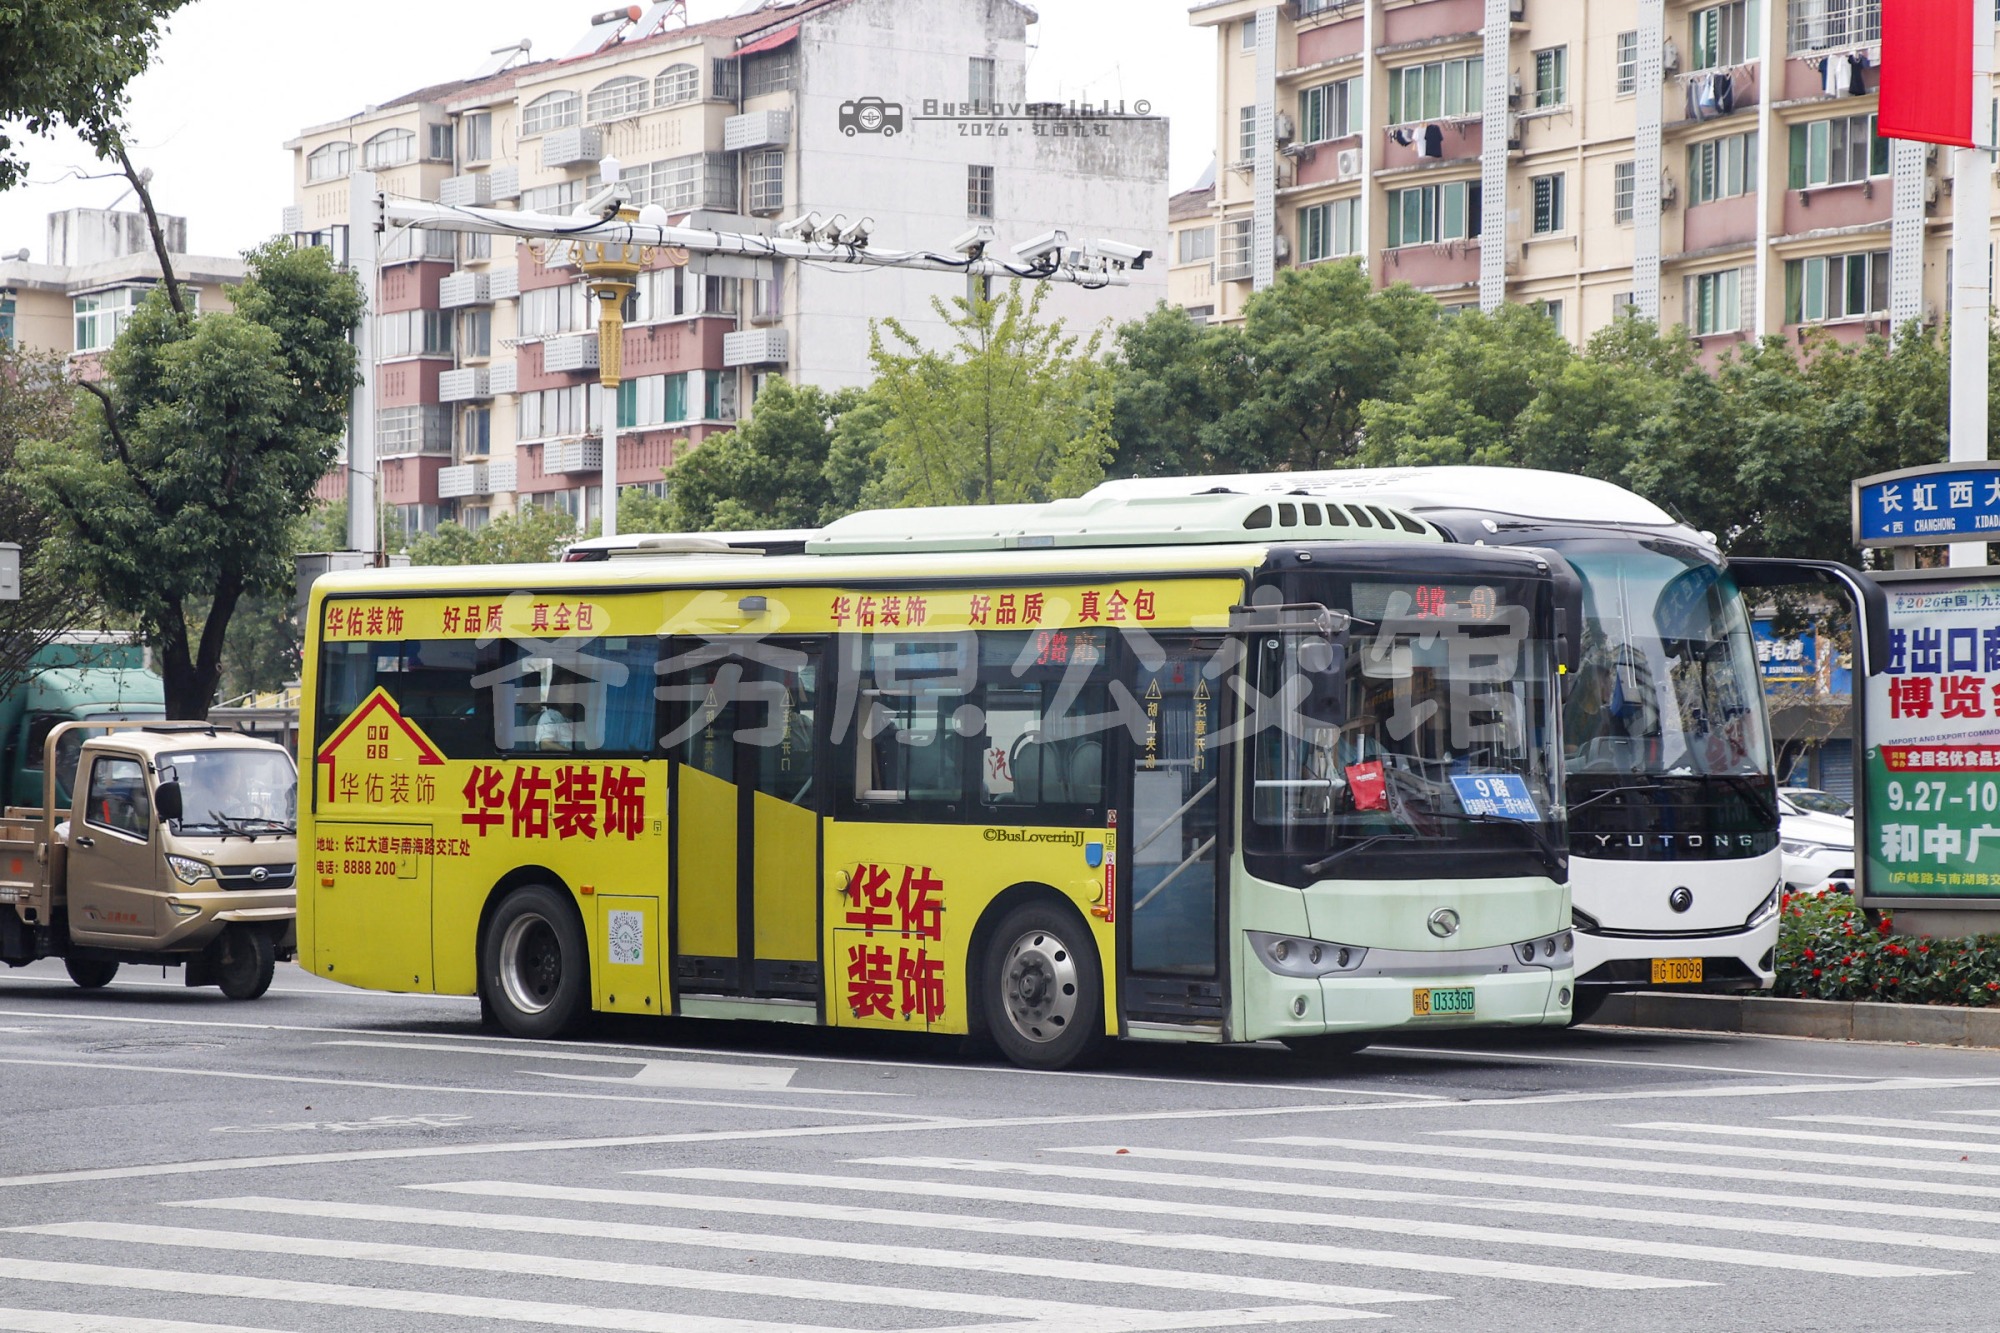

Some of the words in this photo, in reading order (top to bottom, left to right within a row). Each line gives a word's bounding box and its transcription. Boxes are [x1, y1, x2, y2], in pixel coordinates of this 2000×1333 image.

[1893, 521, 1904, 533] 西
[1914, 517, 1956, 532] CHANGHONG
[327, 605, 404, 637] 华佑装饰
[442, 604, 504, 634] 好品质
[531, 602, 594, 631] 真全包
[830, 595, 927, 627] 华佑装饰
[968, 592, 1045, 625] 好品质
[1078, 588, 1156, 622] 真全包
[1888, 675, 2000, 719] 博览
[1888, 737, 1917, 745] IMPORT
[1919, 735, 1936, 743] AND
[1936, 732, 1966, 741] EXPORT
[340, 773, 435, 805] 华佑装饰
[462, 765, 646, 841] 华佑装饰
[1475, 778, 1510, 797] 9路
[1888, 781, 2000, 812] 9.27-10
[1595, 834, 1752, 847] YUTONG
[1881, 823, 2000, 864] 和中广
[846, 864, 945, 942] 华佑
[847, 945, 945, 1022] 装饰
